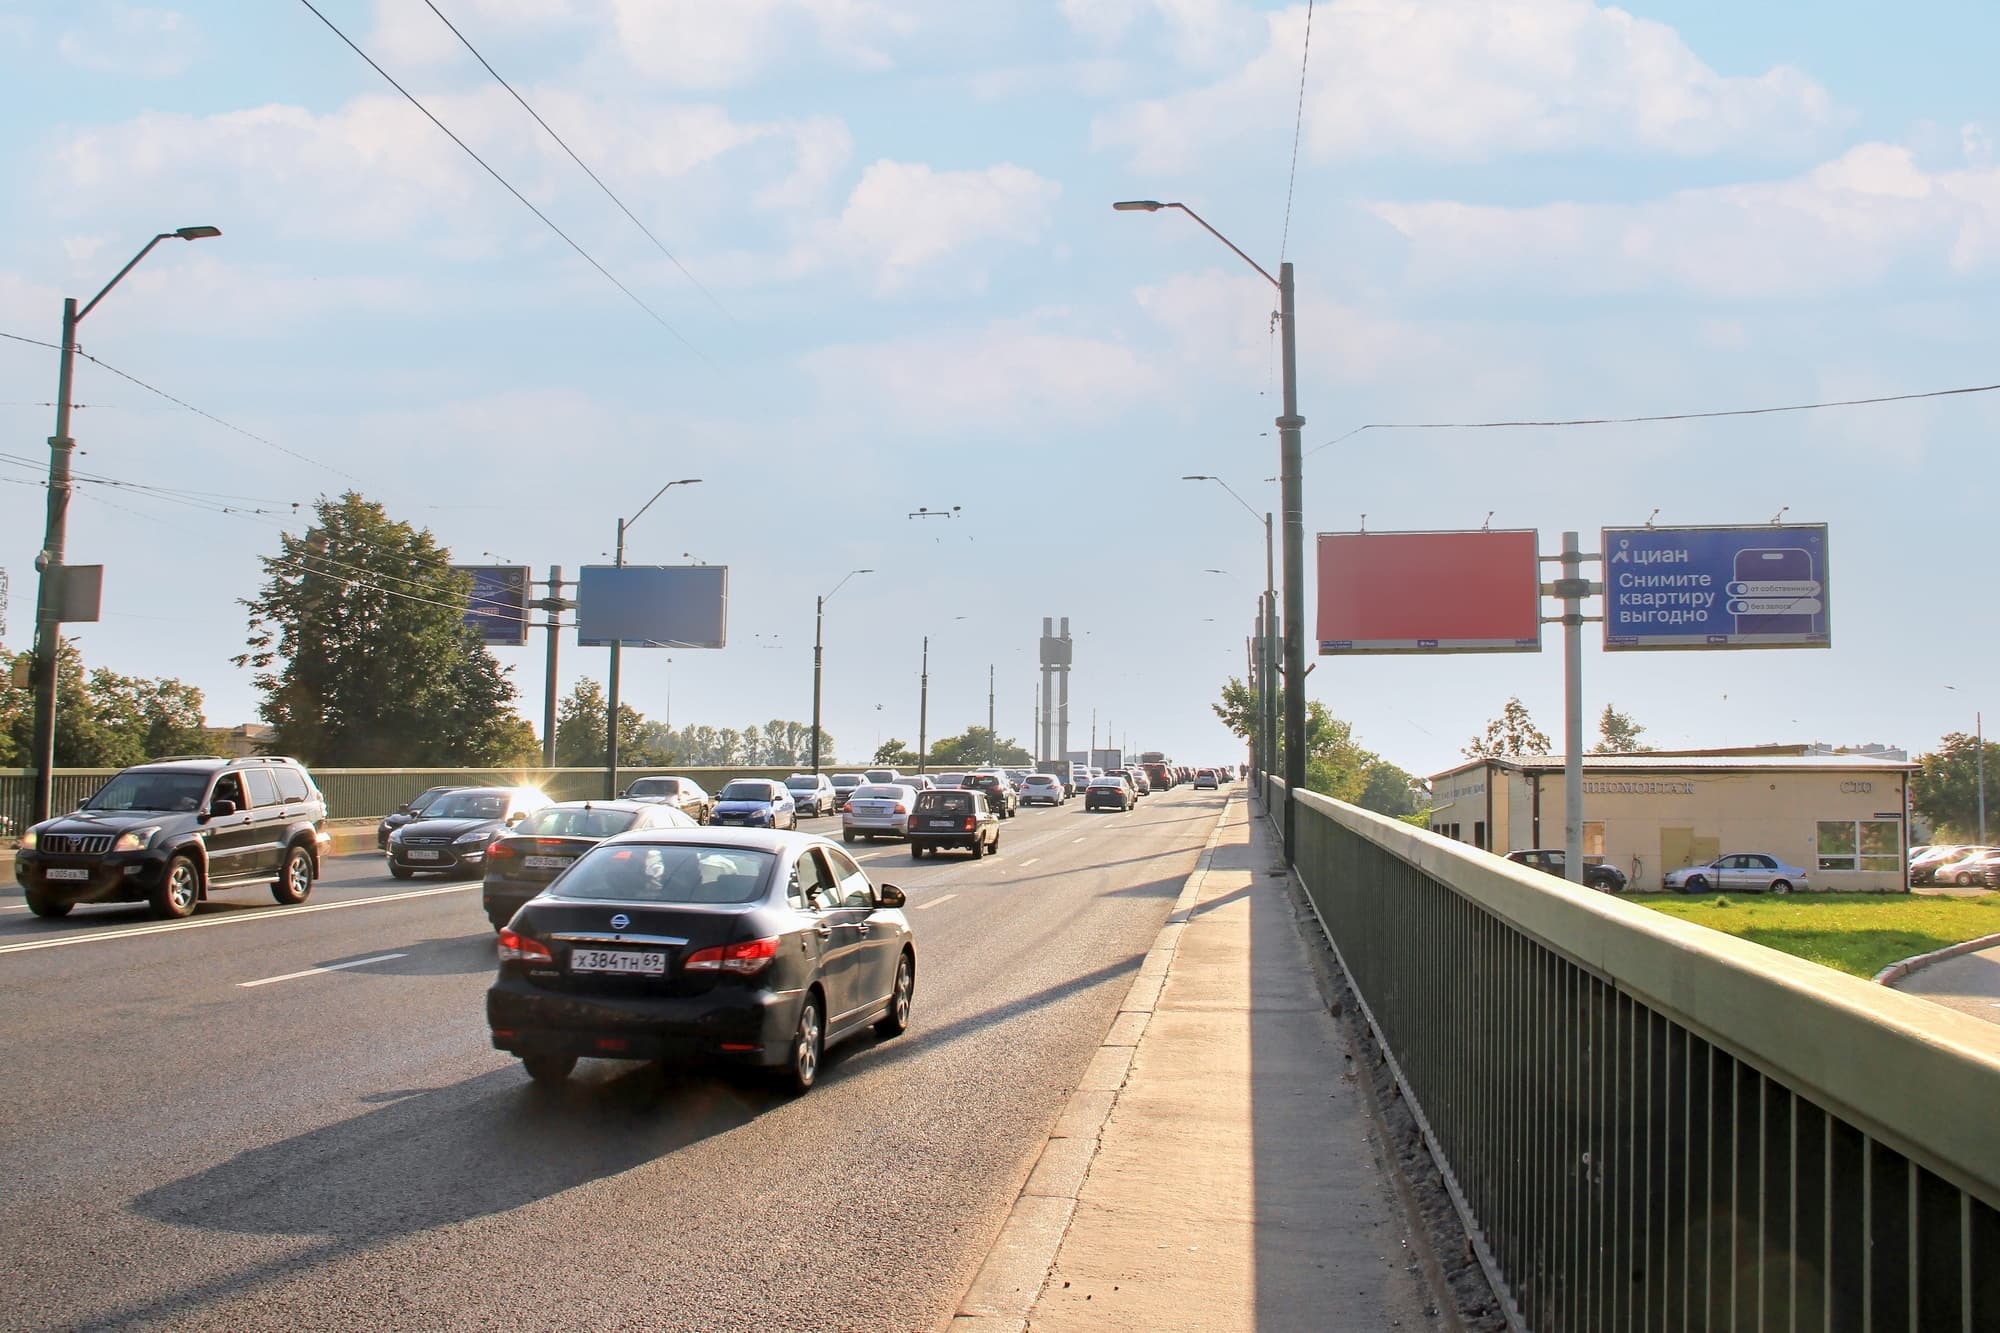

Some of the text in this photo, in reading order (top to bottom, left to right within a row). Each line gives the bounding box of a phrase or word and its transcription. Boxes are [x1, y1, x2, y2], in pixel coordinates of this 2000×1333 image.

[1633, 549, 1688, 564] циан
[1619, 574, 1712, 588] Снимите
[1619, 592, 1715, 608] квартиру
[1620, 609, 1708, 624] выгодно
[1583, 782, 1696, 794] ИНОМОНТАЖ
